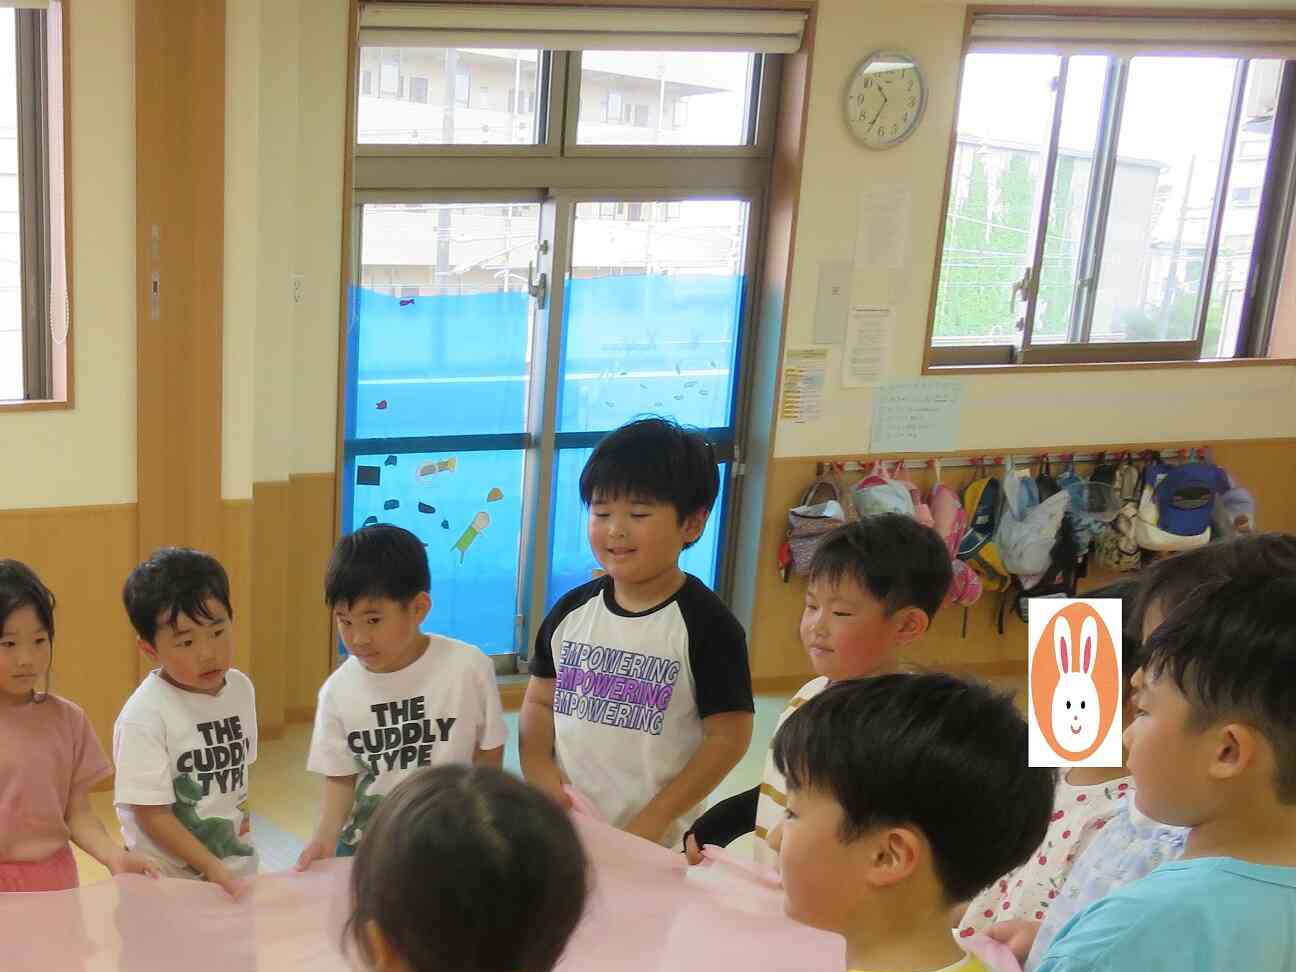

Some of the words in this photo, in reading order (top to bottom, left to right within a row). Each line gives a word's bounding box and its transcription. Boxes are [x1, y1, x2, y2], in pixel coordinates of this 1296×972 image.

[559, 640, 680, 685] EMPOWERING
[554, 667, 673, 711] EMPOWERING
[370, 696, 425, 727] THE
[552, 690, 664, 735] EMPOWERING
[197, 716, 243, 746] THE
[348, 718, 456, 754] CUDDLY
[177, 738, 249, 773] CUDD
[368, 744, 433, 776] TYPE
